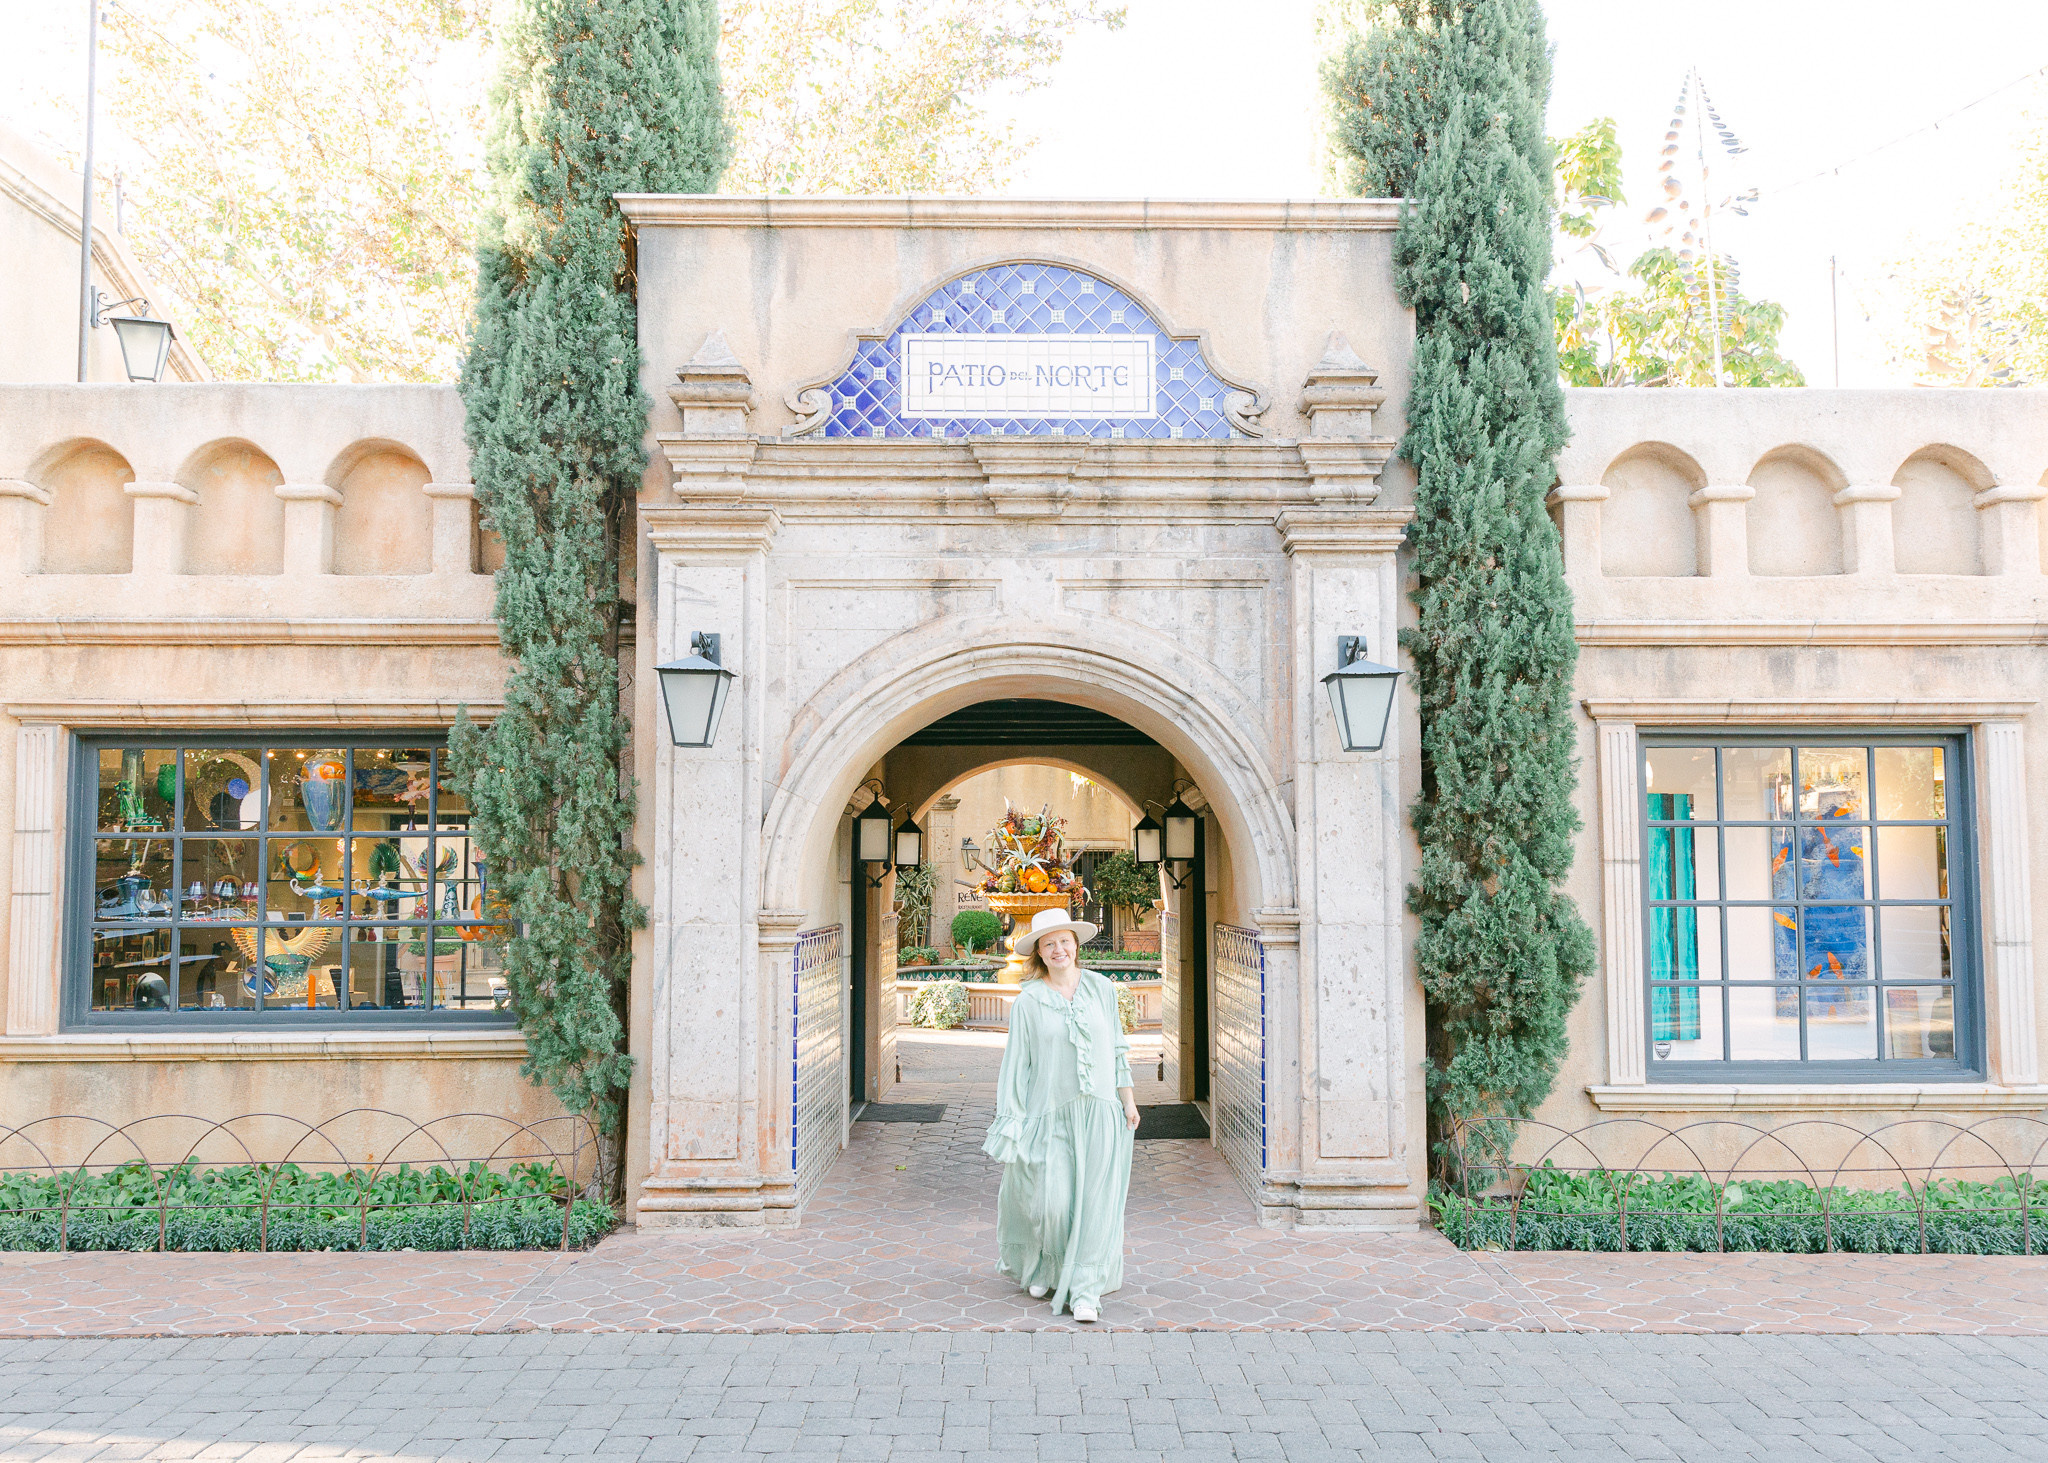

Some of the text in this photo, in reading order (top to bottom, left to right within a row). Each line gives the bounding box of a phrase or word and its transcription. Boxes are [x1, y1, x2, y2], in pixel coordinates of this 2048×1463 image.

[928, 361, 1128, 394] PATIO DEL NORTE
